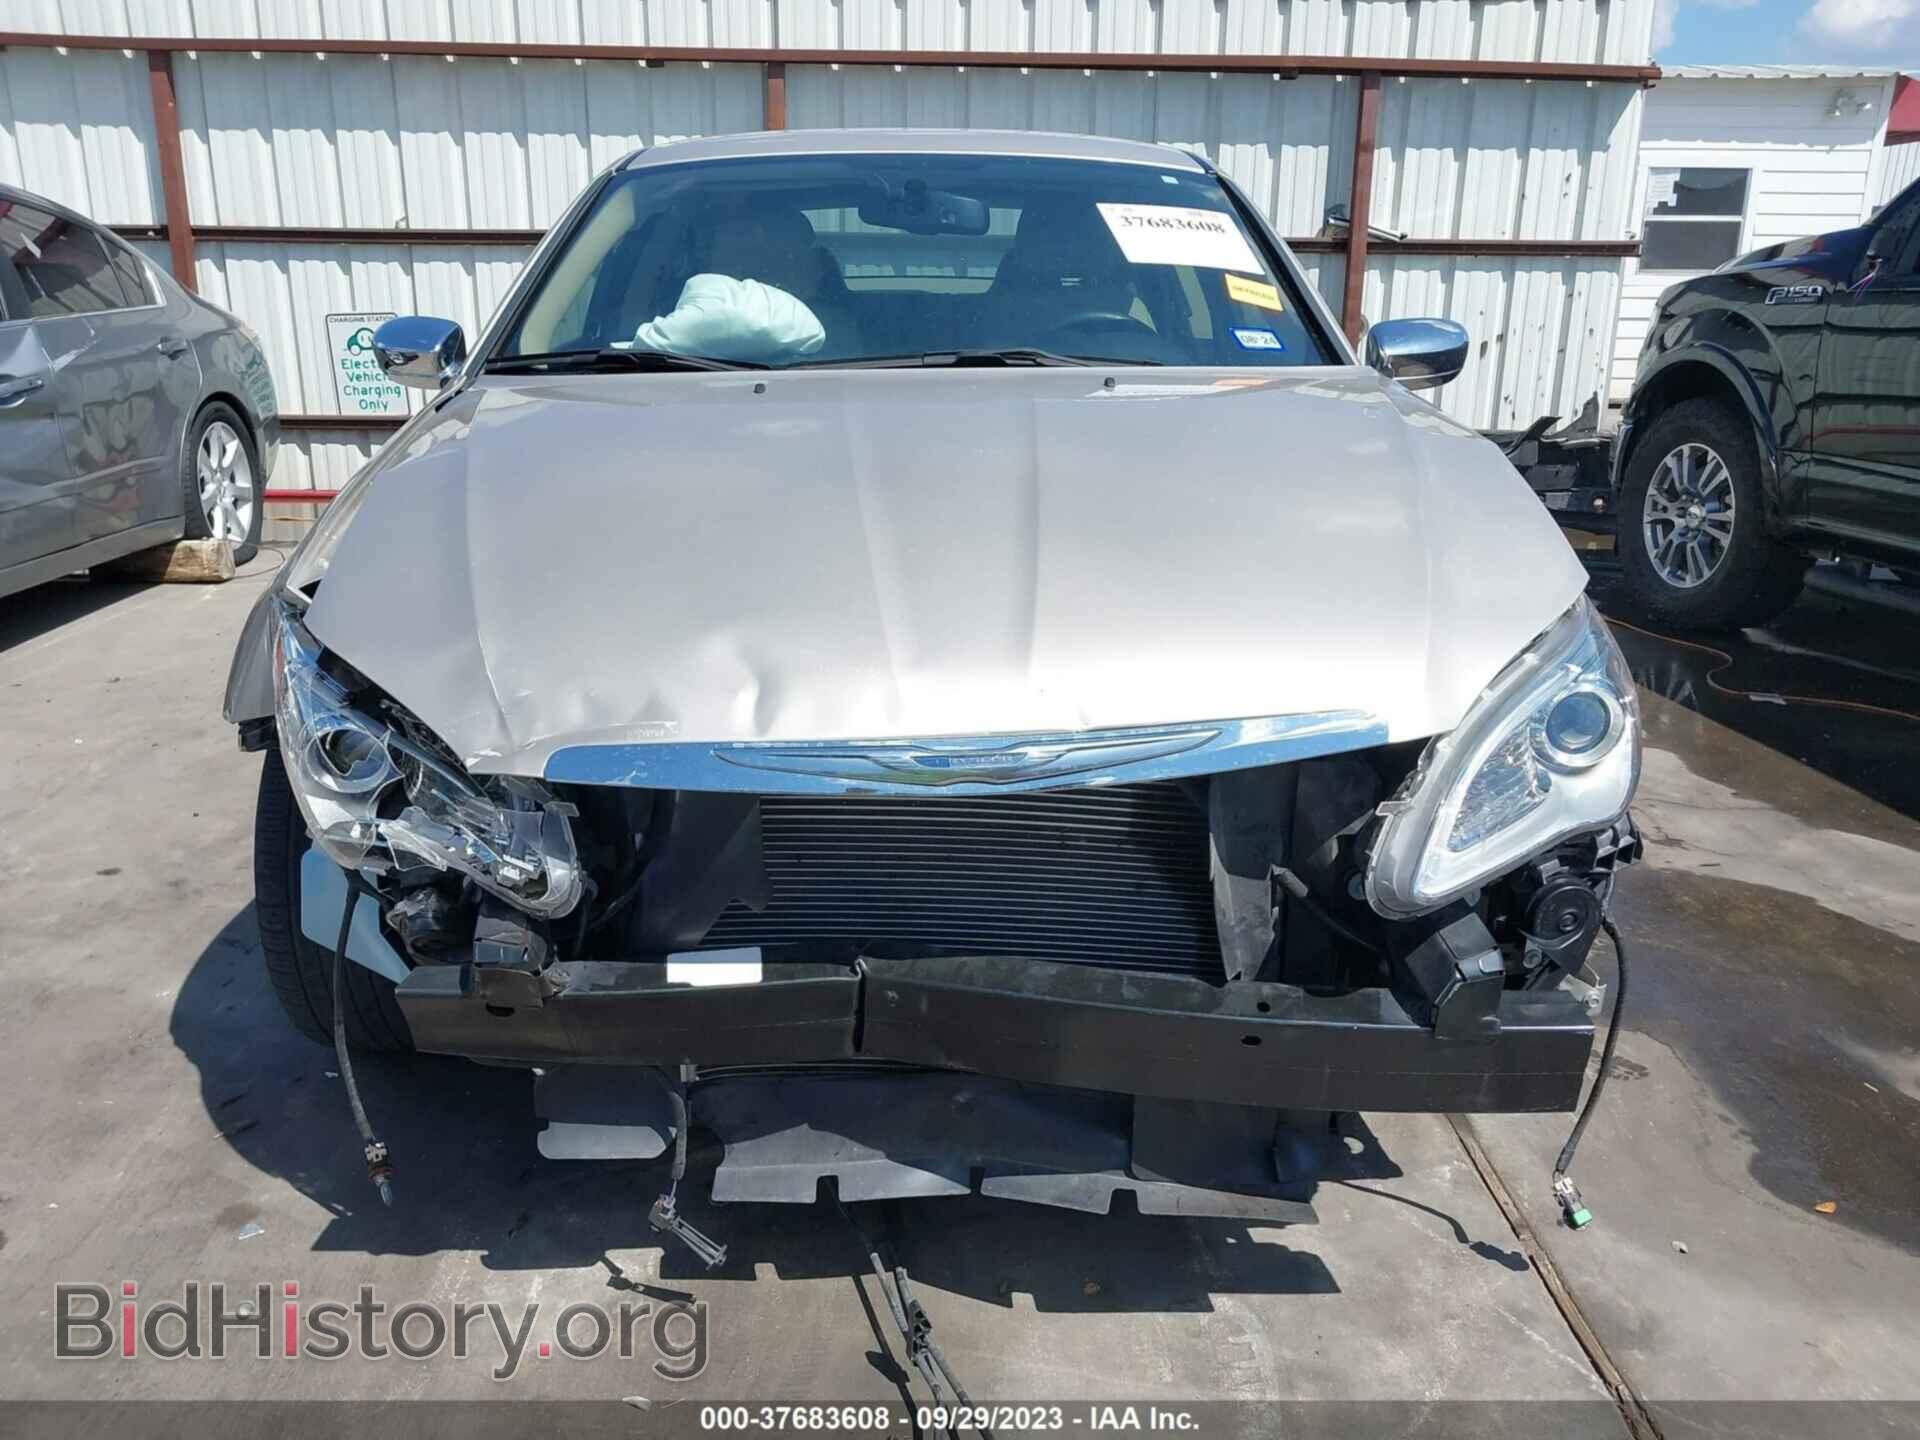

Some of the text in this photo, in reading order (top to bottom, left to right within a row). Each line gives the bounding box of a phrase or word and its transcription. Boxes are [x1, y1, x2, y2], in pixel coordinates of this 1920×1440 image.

[1120, 215, 1226, 233] 37683608
[344, 384, 401, 398] Charging
[359, 399, 389, 411] Only
